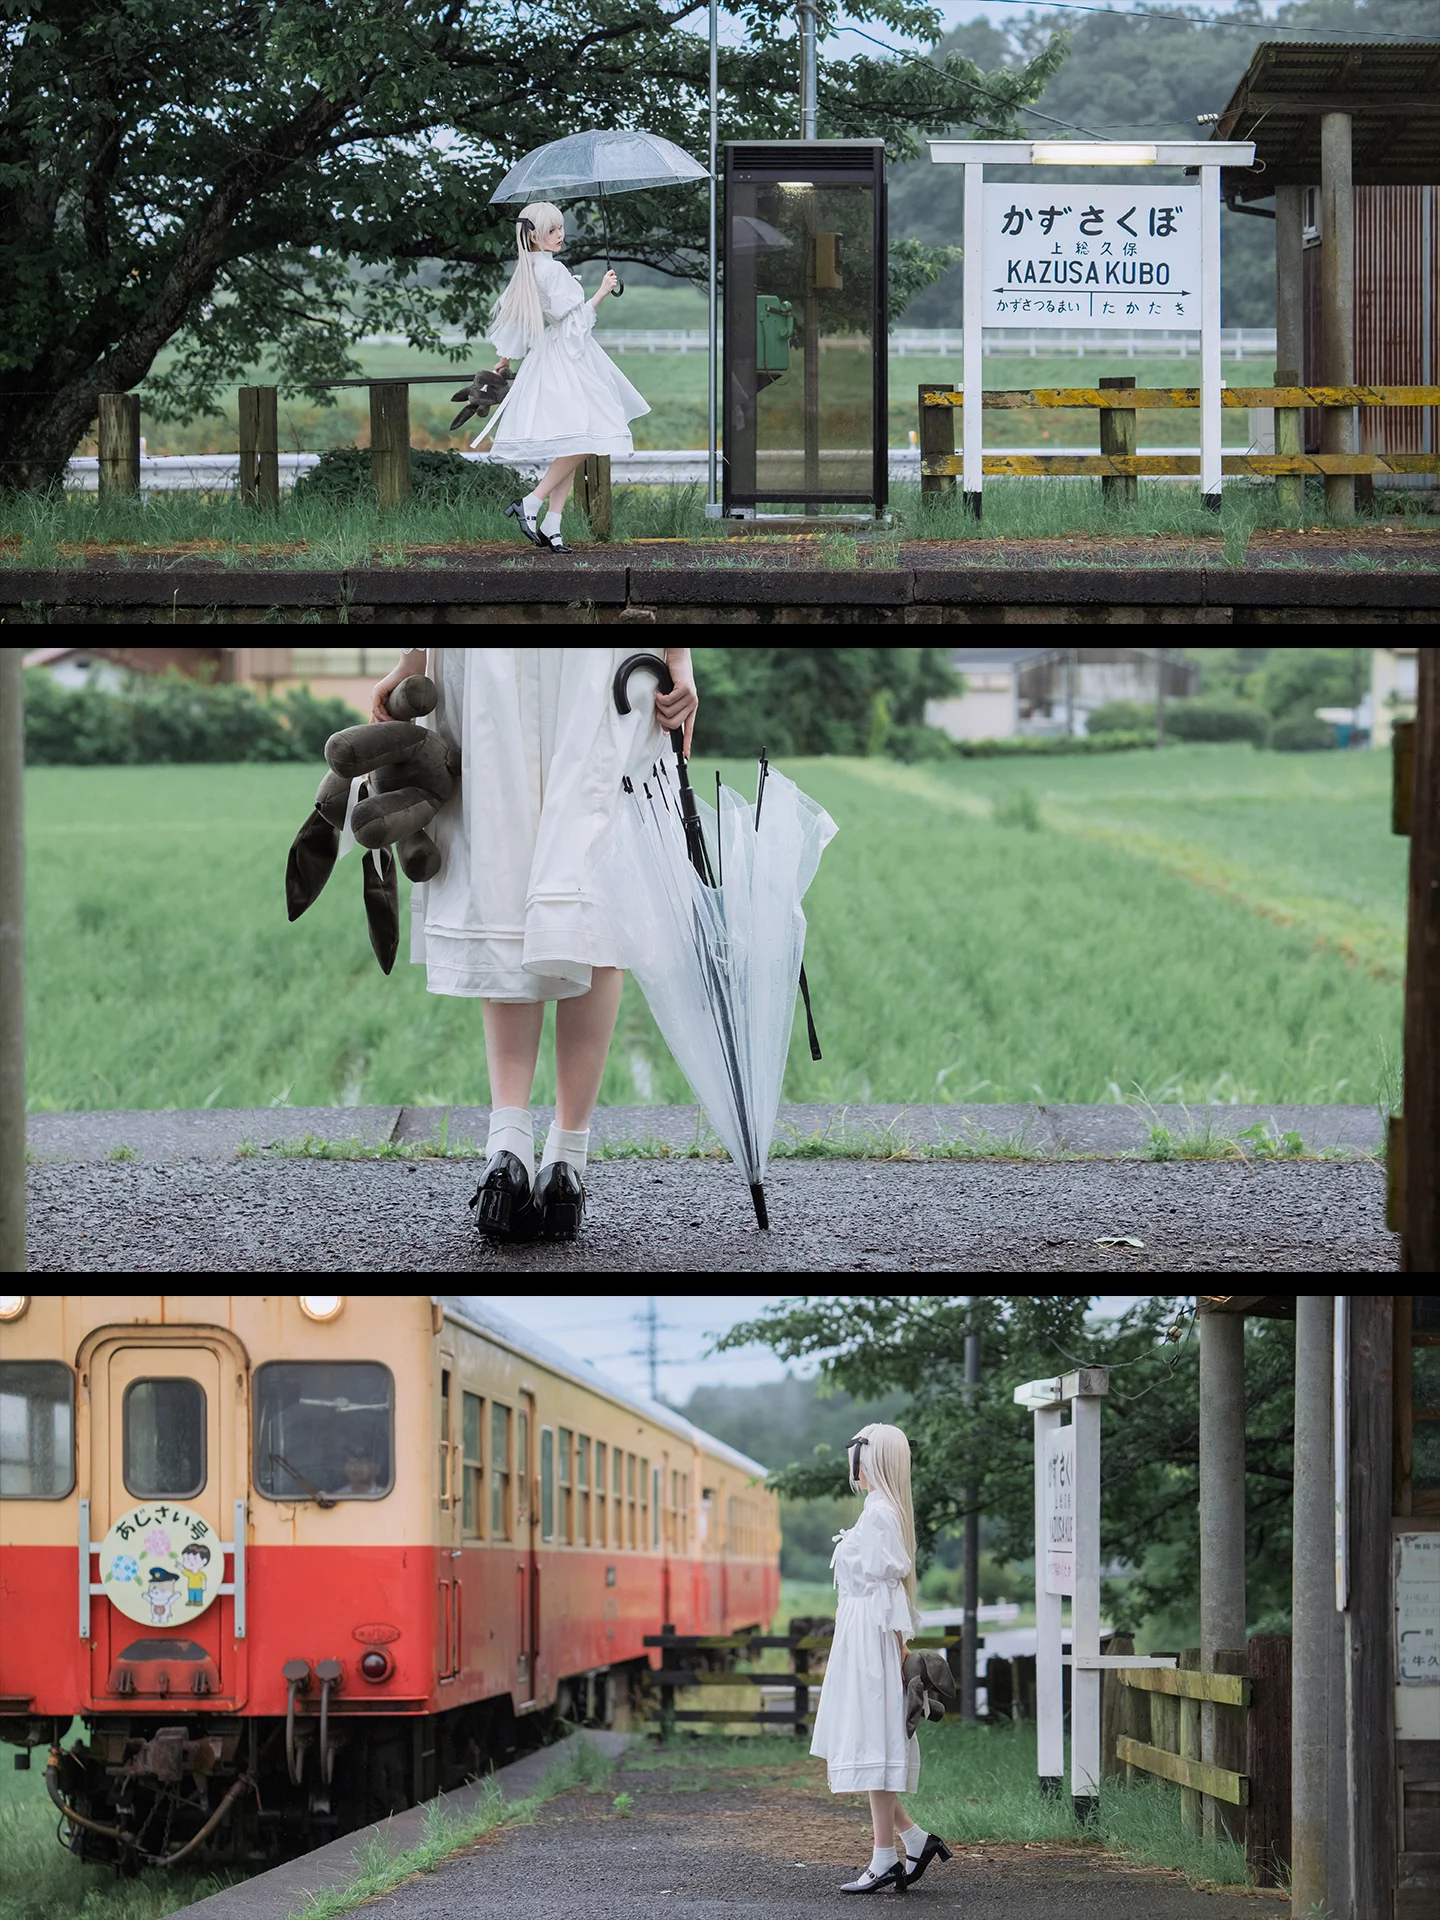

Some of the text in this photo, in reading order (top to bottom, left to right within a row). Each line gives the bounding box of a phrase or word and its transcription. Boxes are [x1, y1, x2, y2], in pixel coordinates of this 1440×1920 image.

[1000, 204, 1184, 238] かずさくぼ
[1050, 241, 1138, 257] 上総久保
[996, 298, 1081, 314] かずさつるまい
[1102, 300, 1186, 316] たかたき
[115, 1505, 210, 1541] あじさい号
